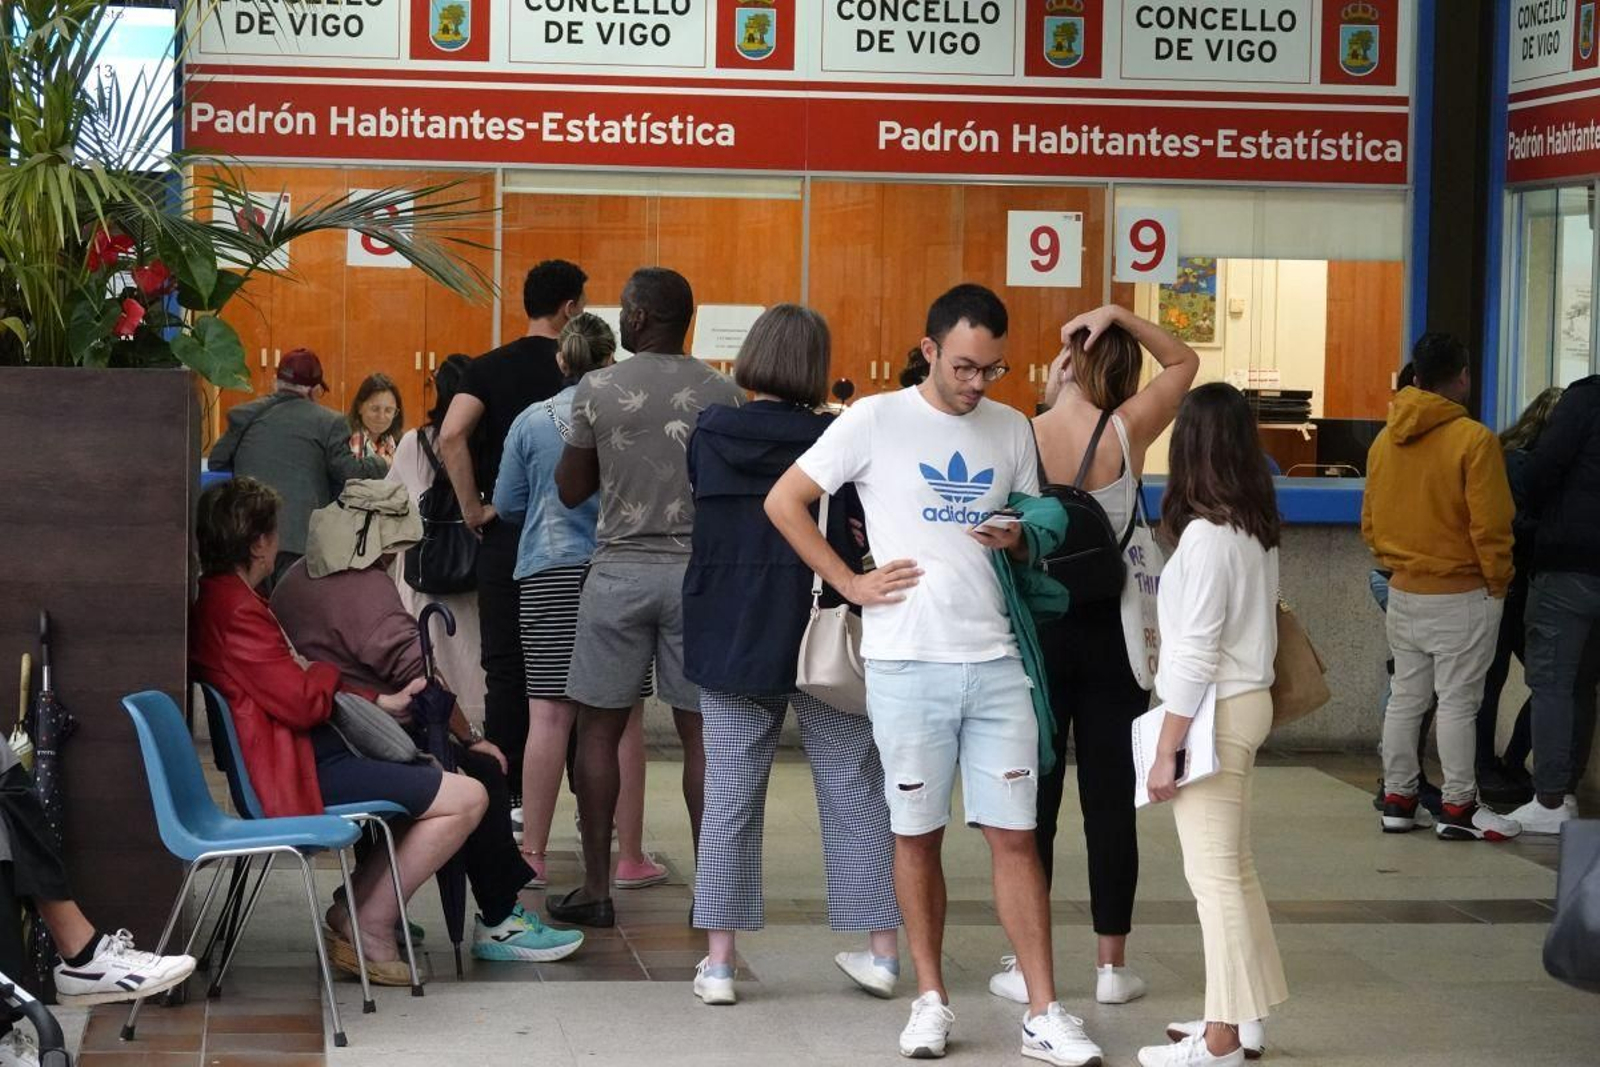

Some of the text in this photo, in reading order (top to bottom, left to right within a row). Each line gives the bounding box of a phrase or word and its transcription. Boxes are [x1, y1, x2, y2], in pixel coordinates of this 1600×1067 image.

[235, 11, 364, 38] DE VIGO
[836, 0, 1001, 25] CONCELLO
[1135, 5, 1297, 33] CONCELLO
[1517, 0, 1567, 30] CONCELLO
[544, 20, 671, 47] DE VIGO
[856, 29, 981, 56] DE VIGO
[1522, 29, 1560, 61] DE VIGO
[1155, 36, 1278, 64] DE VIGO
[190, 102, 736, 146] Padrón Habitantes-Estatística
[878, 120, 1403, 162] Padrón Habitantes-Estatística
[1507, 125, 1544, 161] Padrón
[1029, 224, 1061, 273] 9
[1129, 218, 1167, 273] 9
[1127, 545, 1146, 567] RE
[1143, 627, 1157, 649] RE
